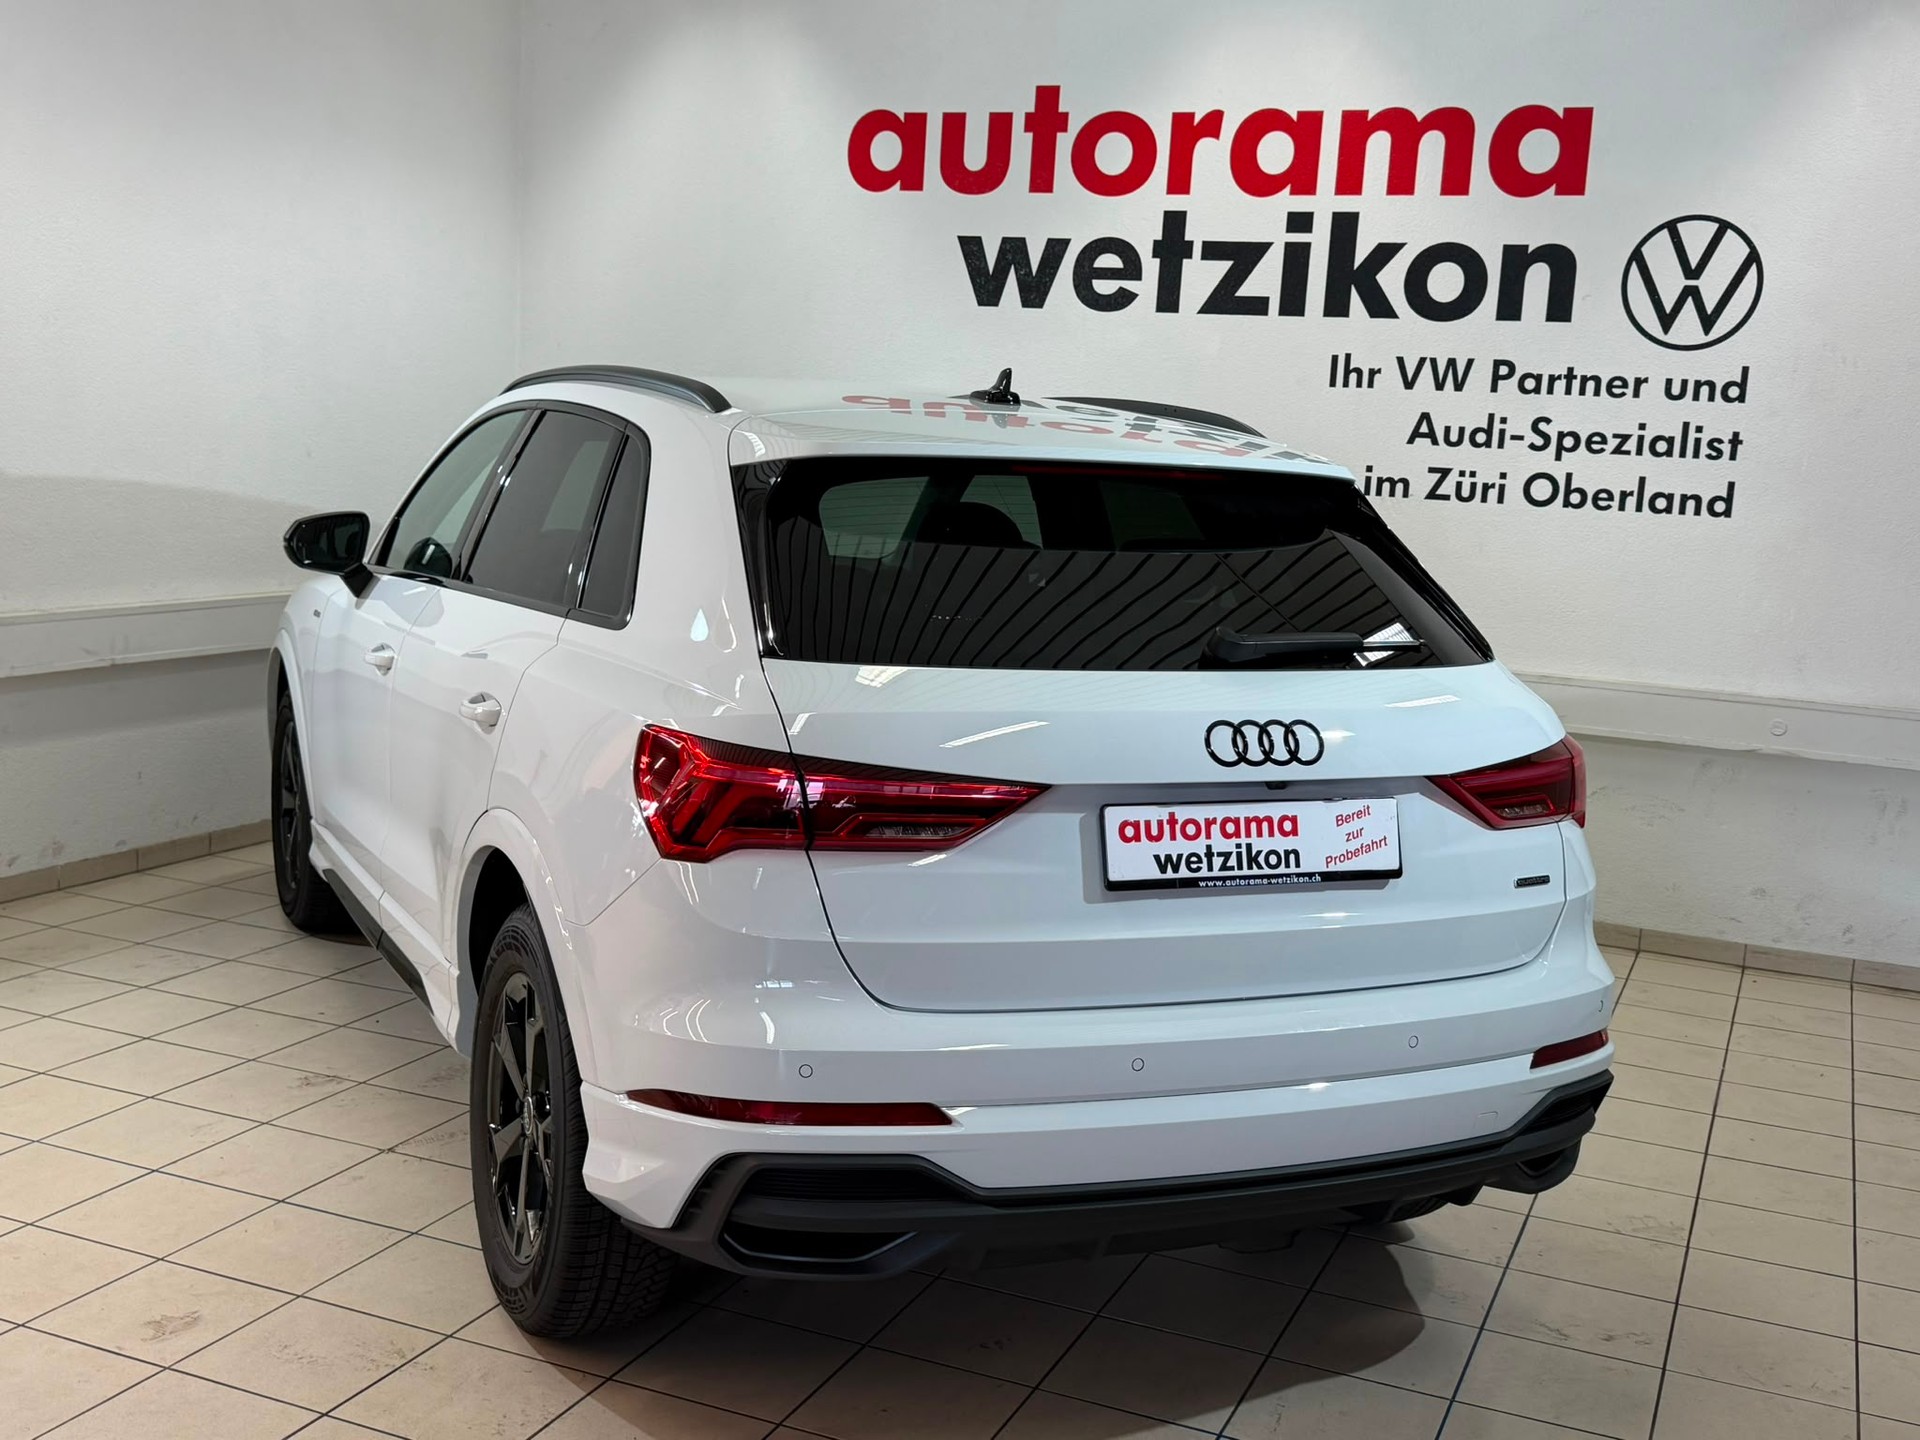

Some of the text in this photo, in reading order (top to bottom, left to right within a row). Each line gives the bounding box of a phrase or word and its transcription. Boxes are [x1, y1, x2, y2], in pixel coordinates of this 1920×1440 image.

[848, 86, 1594, 197] autorama
[957, 211, 1578, 323] wetzikon
[1329, 353, 1749, 404] Ihr VW Partner und
[1407, 412, 1744, 461] Audi-Spezialist
[1364, 465, 1736, 518] im Züri Oberland
[1118, 812, 1299, 844] autorama
[1335, 804, 1371, 827] Bereit
[1345, 827, 1364, 842] zur
[1152, 842, 1301, 875] wetzikon
[1325, 835, 1388, 868] Probefahrt
[1198, 873, 1322, 887] www.autorama-wetzikon.ch
